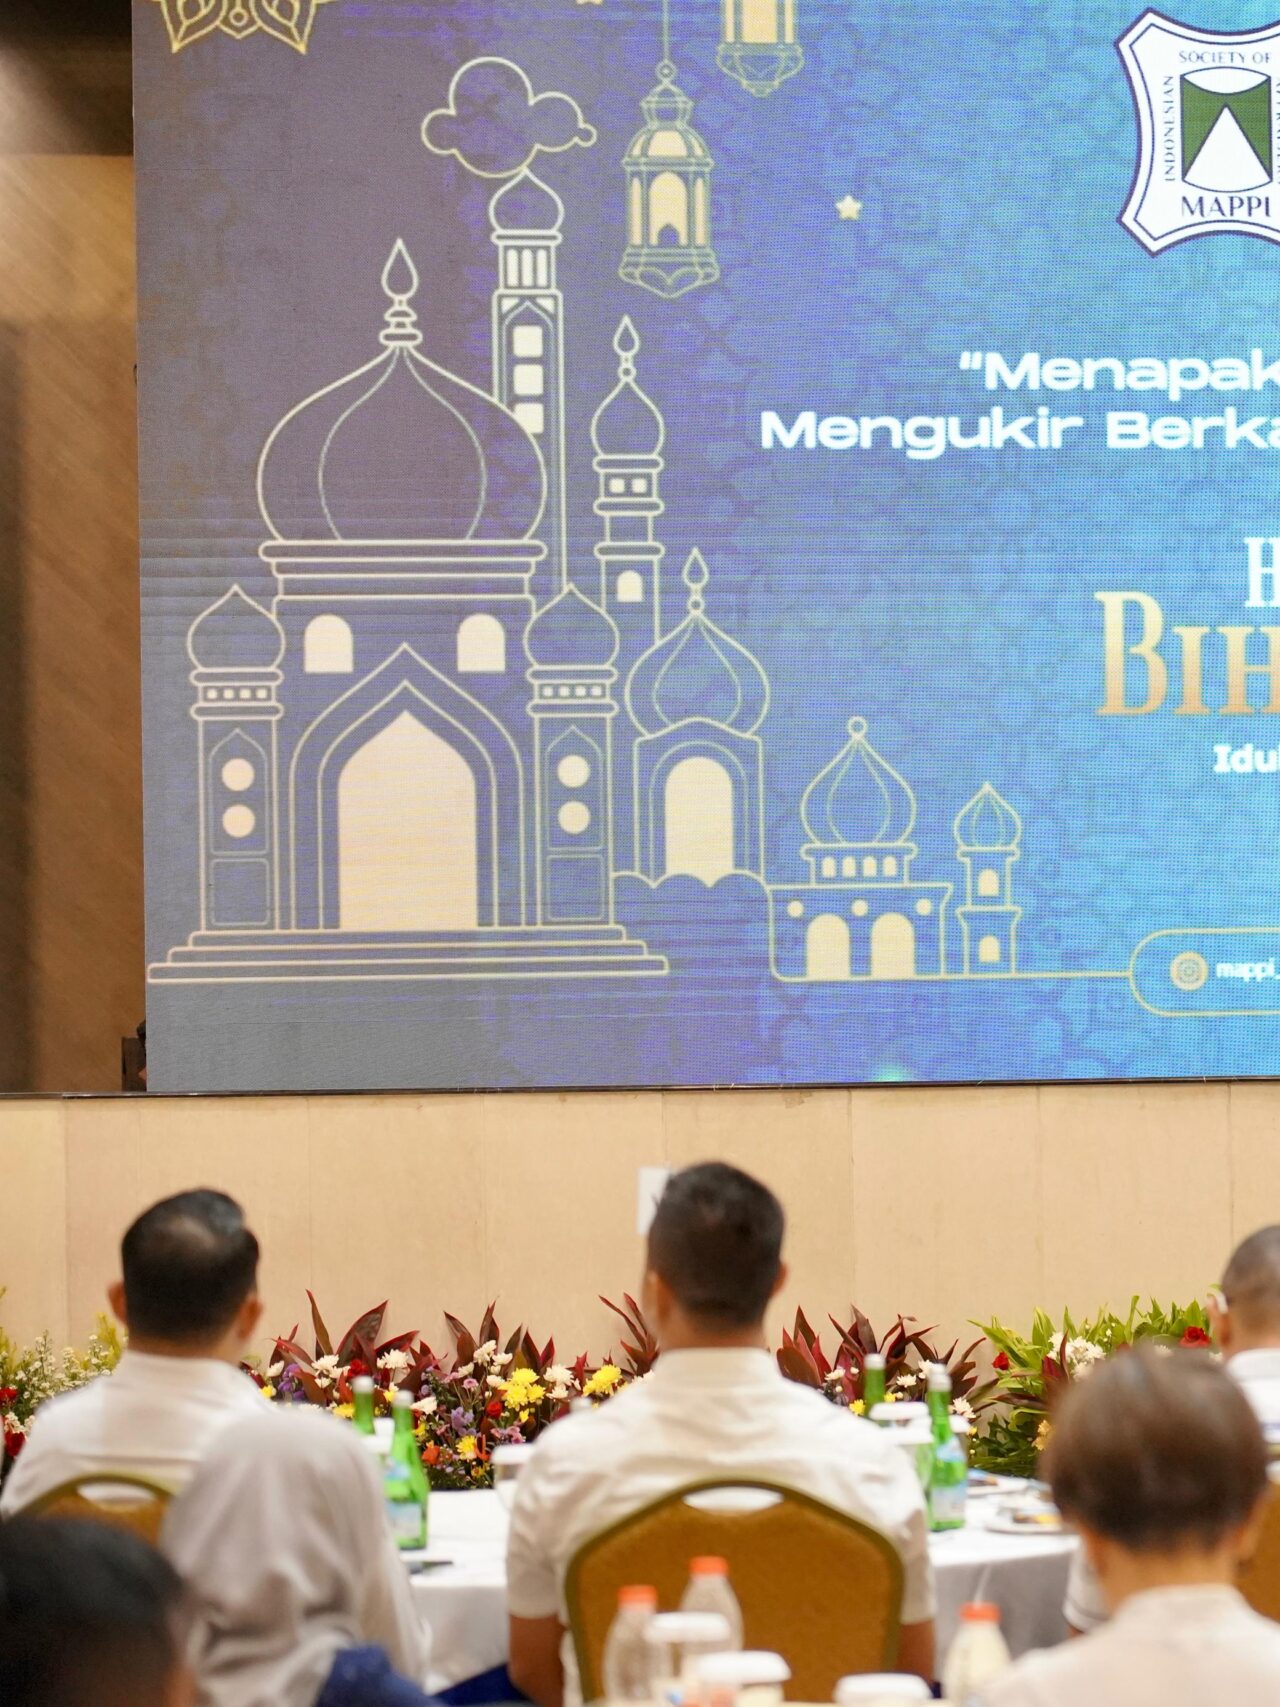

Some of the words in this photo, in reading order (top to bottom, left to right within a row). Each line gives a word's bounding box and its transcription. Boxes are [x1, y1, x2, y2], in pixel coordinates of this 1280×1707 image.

[1178, 51, 1245, 64] SOCIETY
[1252, 52, 1271, 64] OF
[1162, 75, 1176, 182] INDONESIAN
[1181, 195, 1272, 218] MAPPI
[760, 406, 1084, 459] Mengukir
